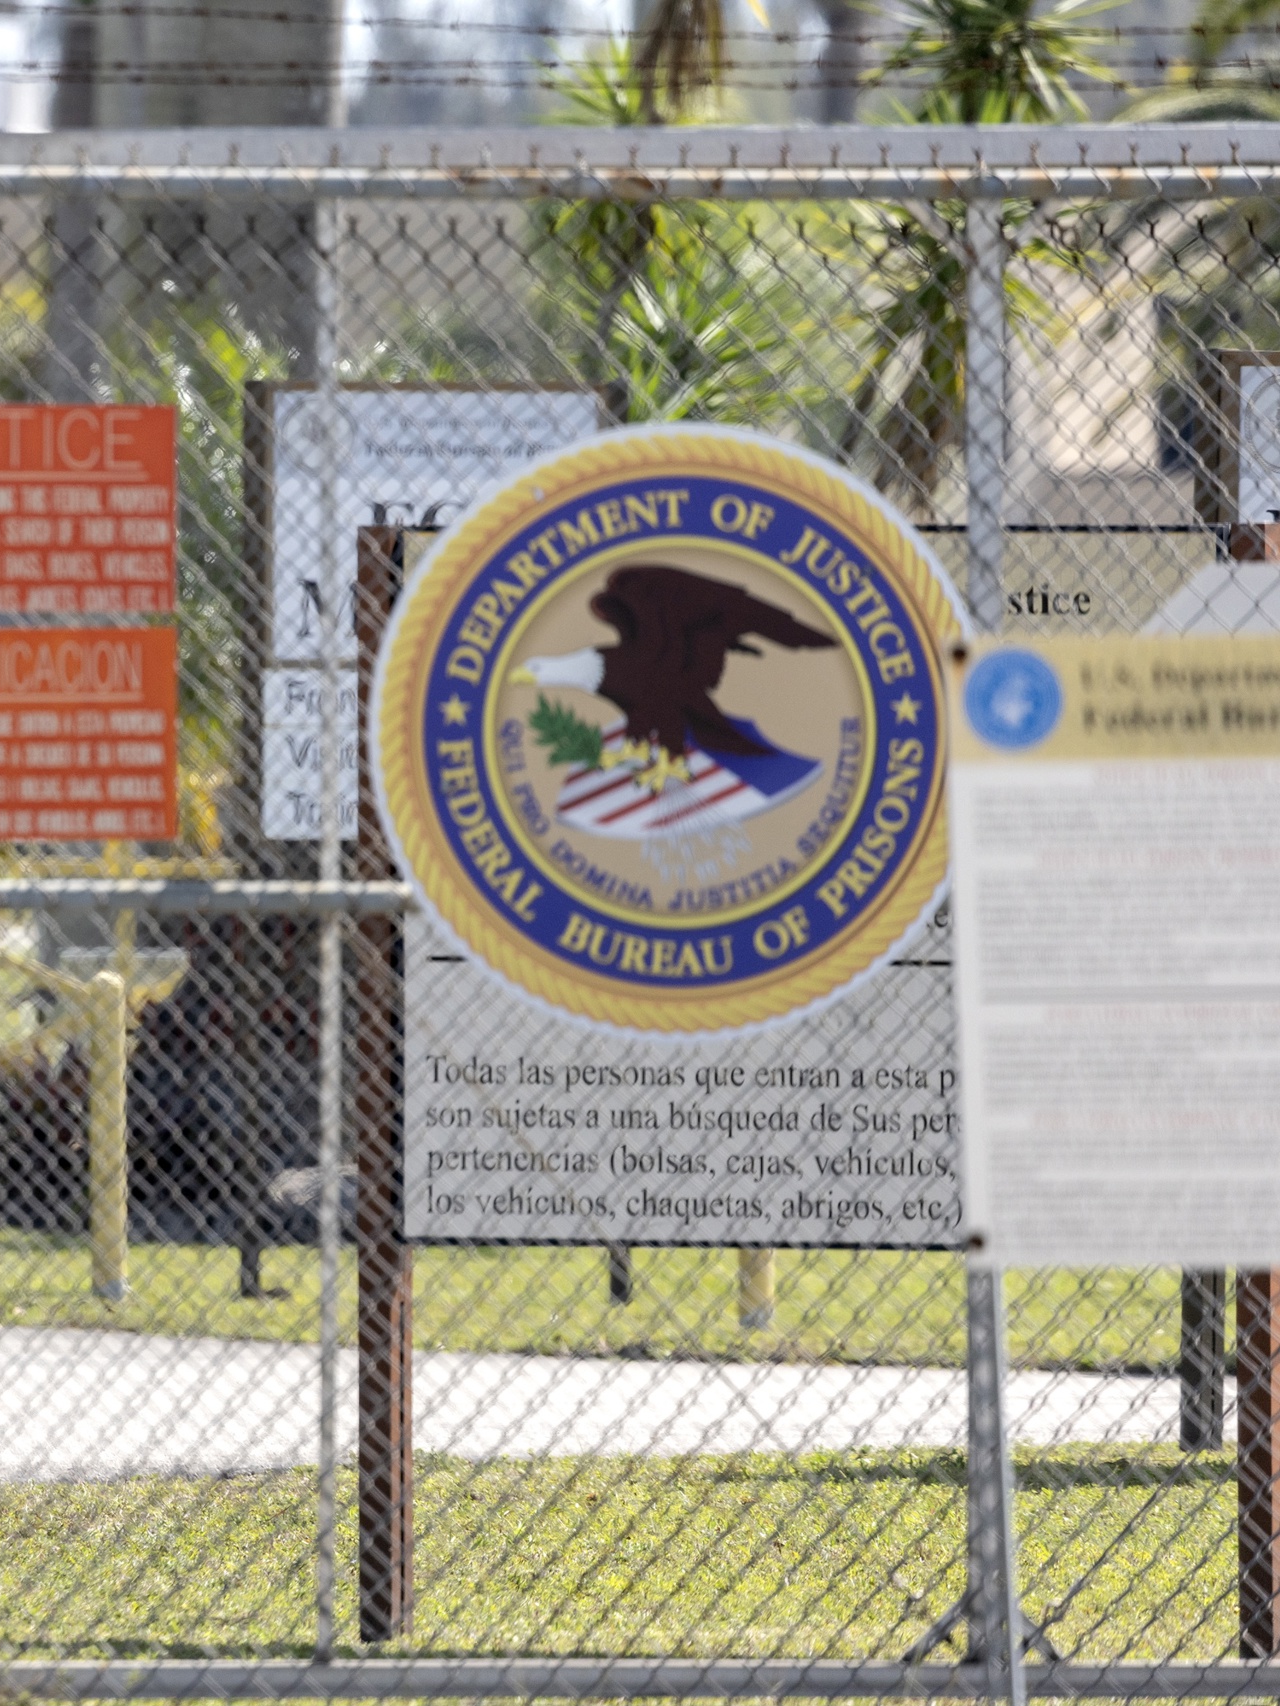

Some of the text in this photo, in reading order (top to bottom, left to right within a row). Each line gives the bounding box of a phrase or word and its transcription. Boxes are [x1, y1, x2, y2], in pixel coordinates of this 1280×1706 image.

[445, 489, 916, 685] DEPARTMENT OF JUSTICE
[1007, 582, 1092, 616] stice
[437, 739, 543, 922] FEDERAL
[558, 911, 734, 978] BUREAU
[753, 905, 810, 958] OF
[816, 738, 924, 919] PRISONS
[550, 840, 654, 908] DOMINA
[667, 857, 797, 911] JUSTITIA
[426, 1054, 507, 1086] Todas
[518, 1056, 555, 1086] las
[565, 1064, 685, 1093] personas
[695, 1065, 746, 1094] que
[755, 1065, 841, 1089] entran
[851, 1067, 866, 1089] a
[875, 1063, 929, 1089] esta
[425, 1106, 472, 1129] son
[482, 1099, 576, 1135] sujetas
[586, 1108, 600, 1129] a
[611, 1108, 660, 1130] una
[670, 1101, 800, 1138] búsqueda
[810, 1103, 843, 1133] de
[852, 1103, 901, 1133] Sus
[609, 1144, 717, 1181] (bolsas,
[726, 1146, 805, 1183] cajas,
[426, 1185, 466, 1215] los
[626, 1188, 772, 1226] chaquetas,
[781, 1190, 893, 1228] abrigos,
